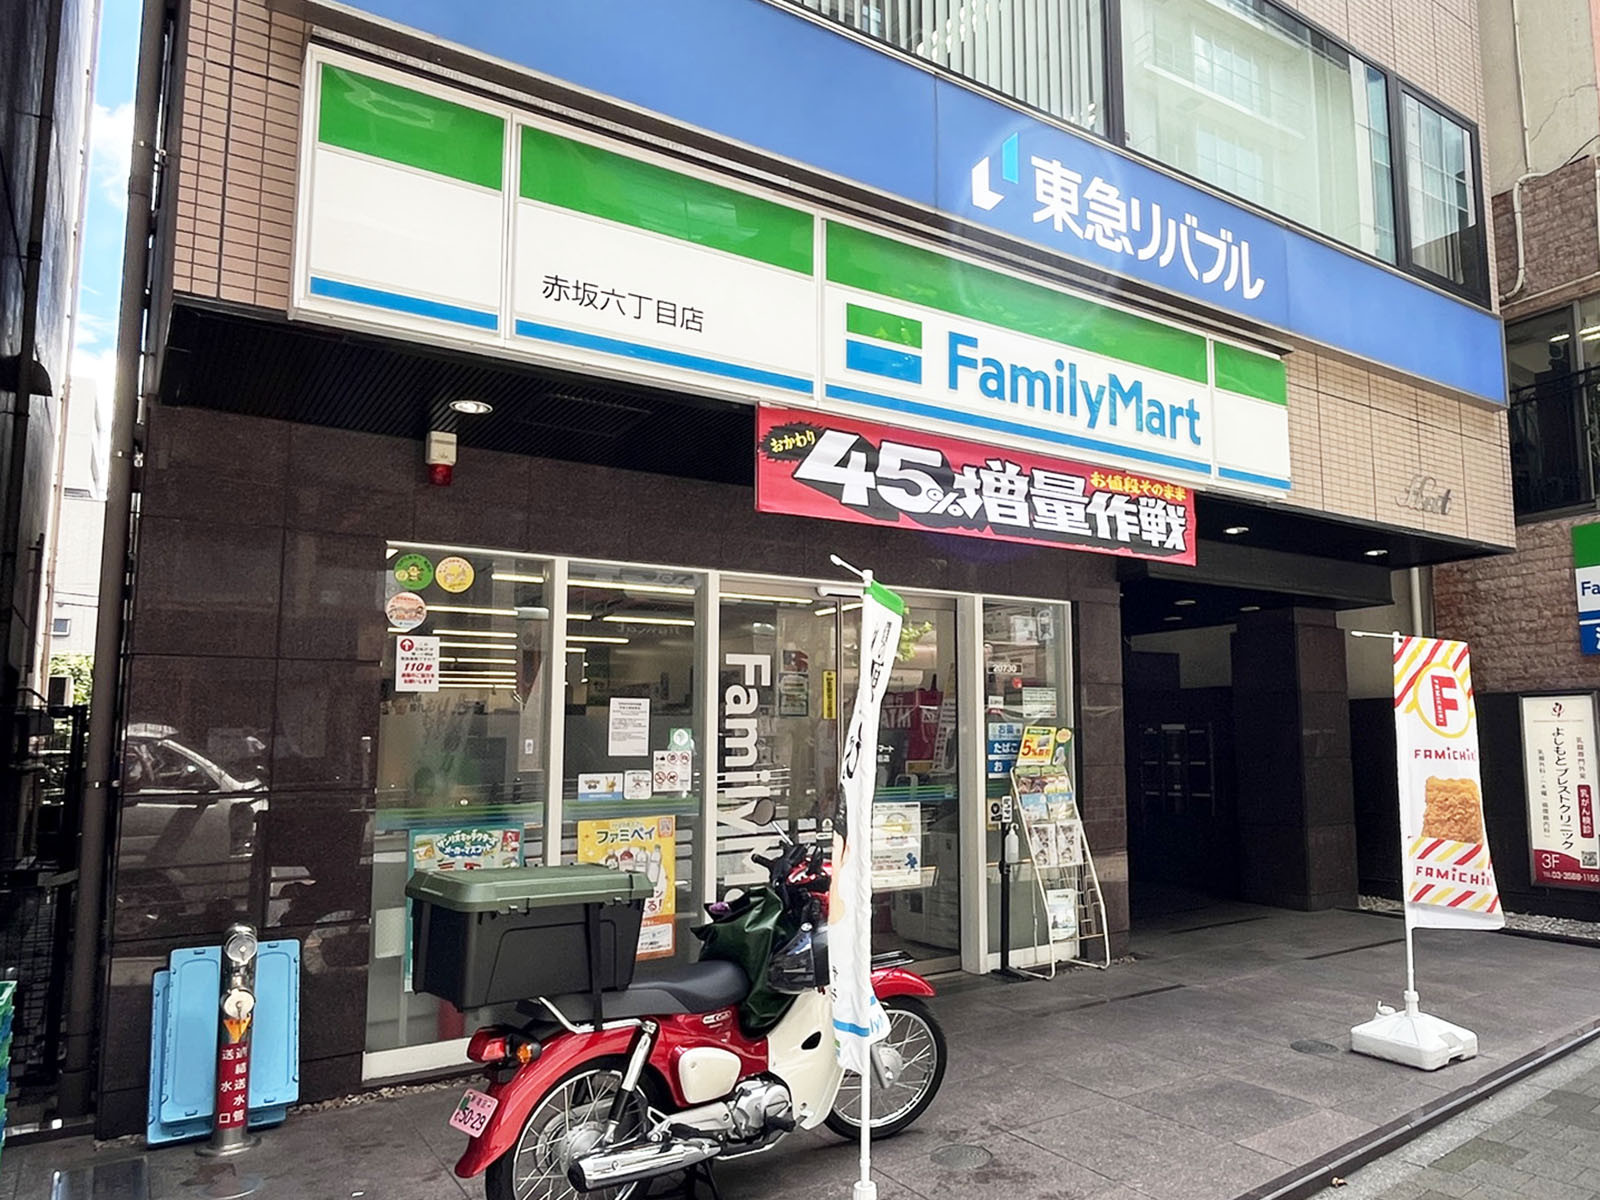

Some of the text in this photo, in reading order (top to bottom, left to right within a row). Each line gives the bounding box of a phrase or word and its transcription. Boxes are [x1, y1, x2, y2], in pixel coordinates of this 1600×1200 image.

[1031, 155, 1264, 300] 東急リバブル
[541, 274, 704, 333] 赤坂六丁目店
[948, 331, 1202, 446] FamilyMart
[769, 431, 817, 453] おかわり
[1090, 470, 1187, 501] お値段そのまま
[596, 827, 656, 844] ファミペイ
[1541, 853, 1560, 869] 3F
[219, 1049, 234, 1124] 送水口
[459, 1106, 486, 1131] 50-29
